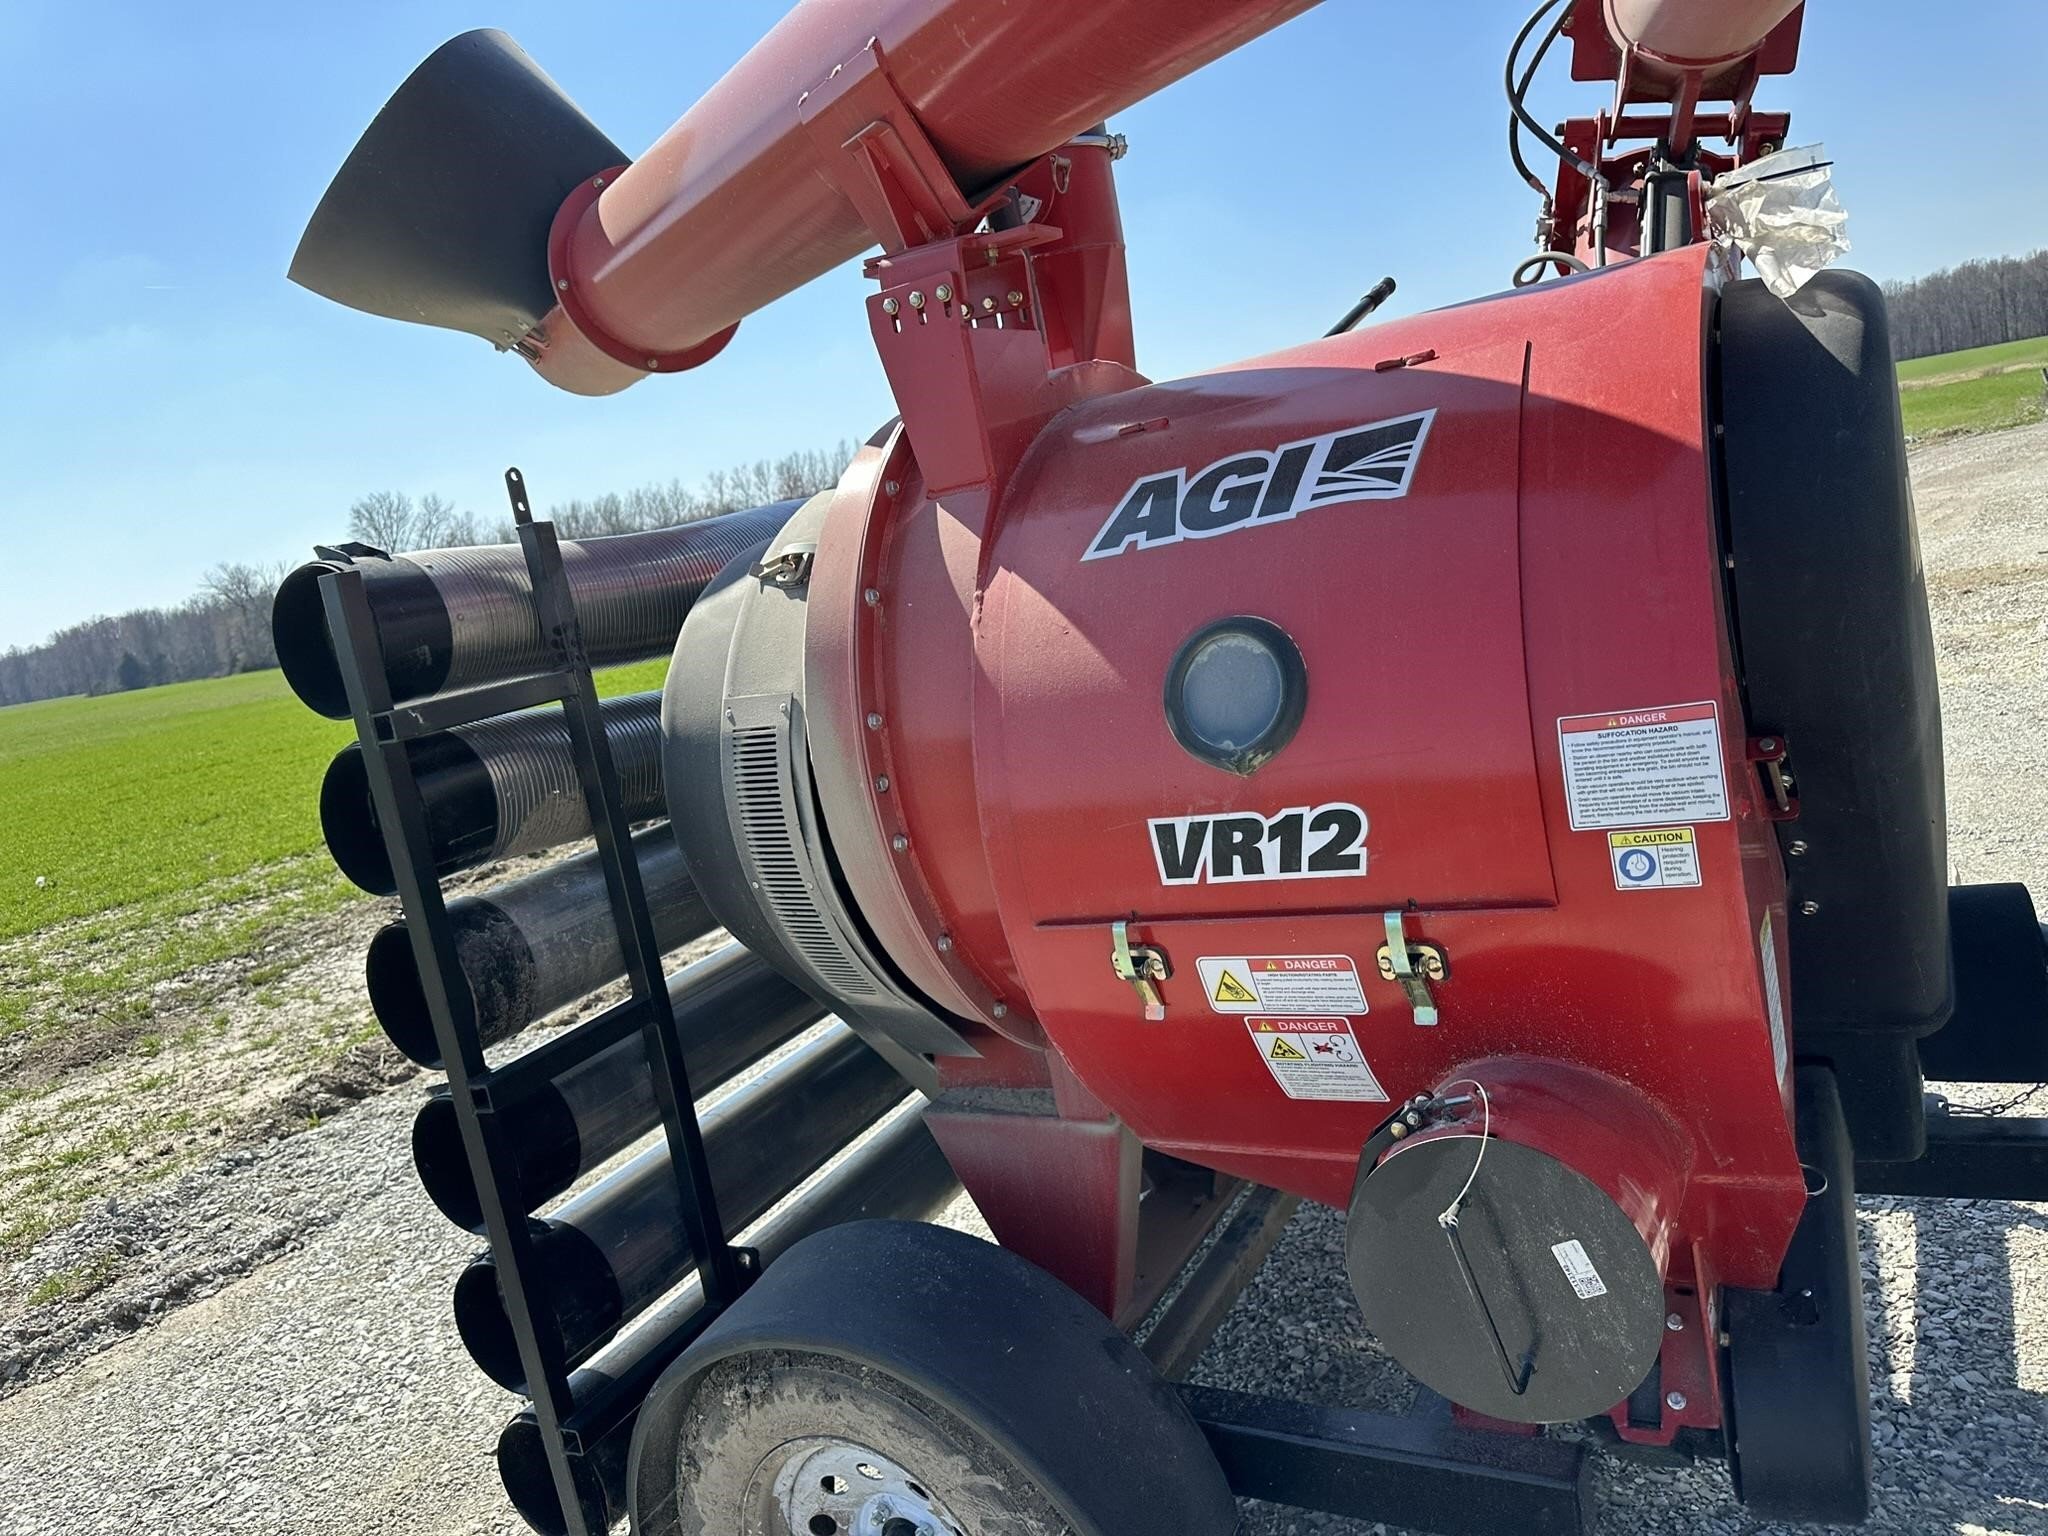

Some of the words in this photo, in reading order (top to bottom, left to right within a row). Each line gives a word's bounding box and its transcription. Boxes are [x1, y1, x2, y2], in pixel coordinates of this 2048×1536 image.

[1090, 441, 1319, 554] AGI
[1619, 712, 1667, 725] DANGER
[1597, 728, 1647, 739] SUFFOCATION
[1648, 725, 1679, 734] HAZARD
[1153, 808, 1363, 880] VR12
[1633, 832, 1683, 844] CAUTION
[1285, 960, 1337, 969] DANGER
[1277, 1021, 1338, 1031] DANGER
